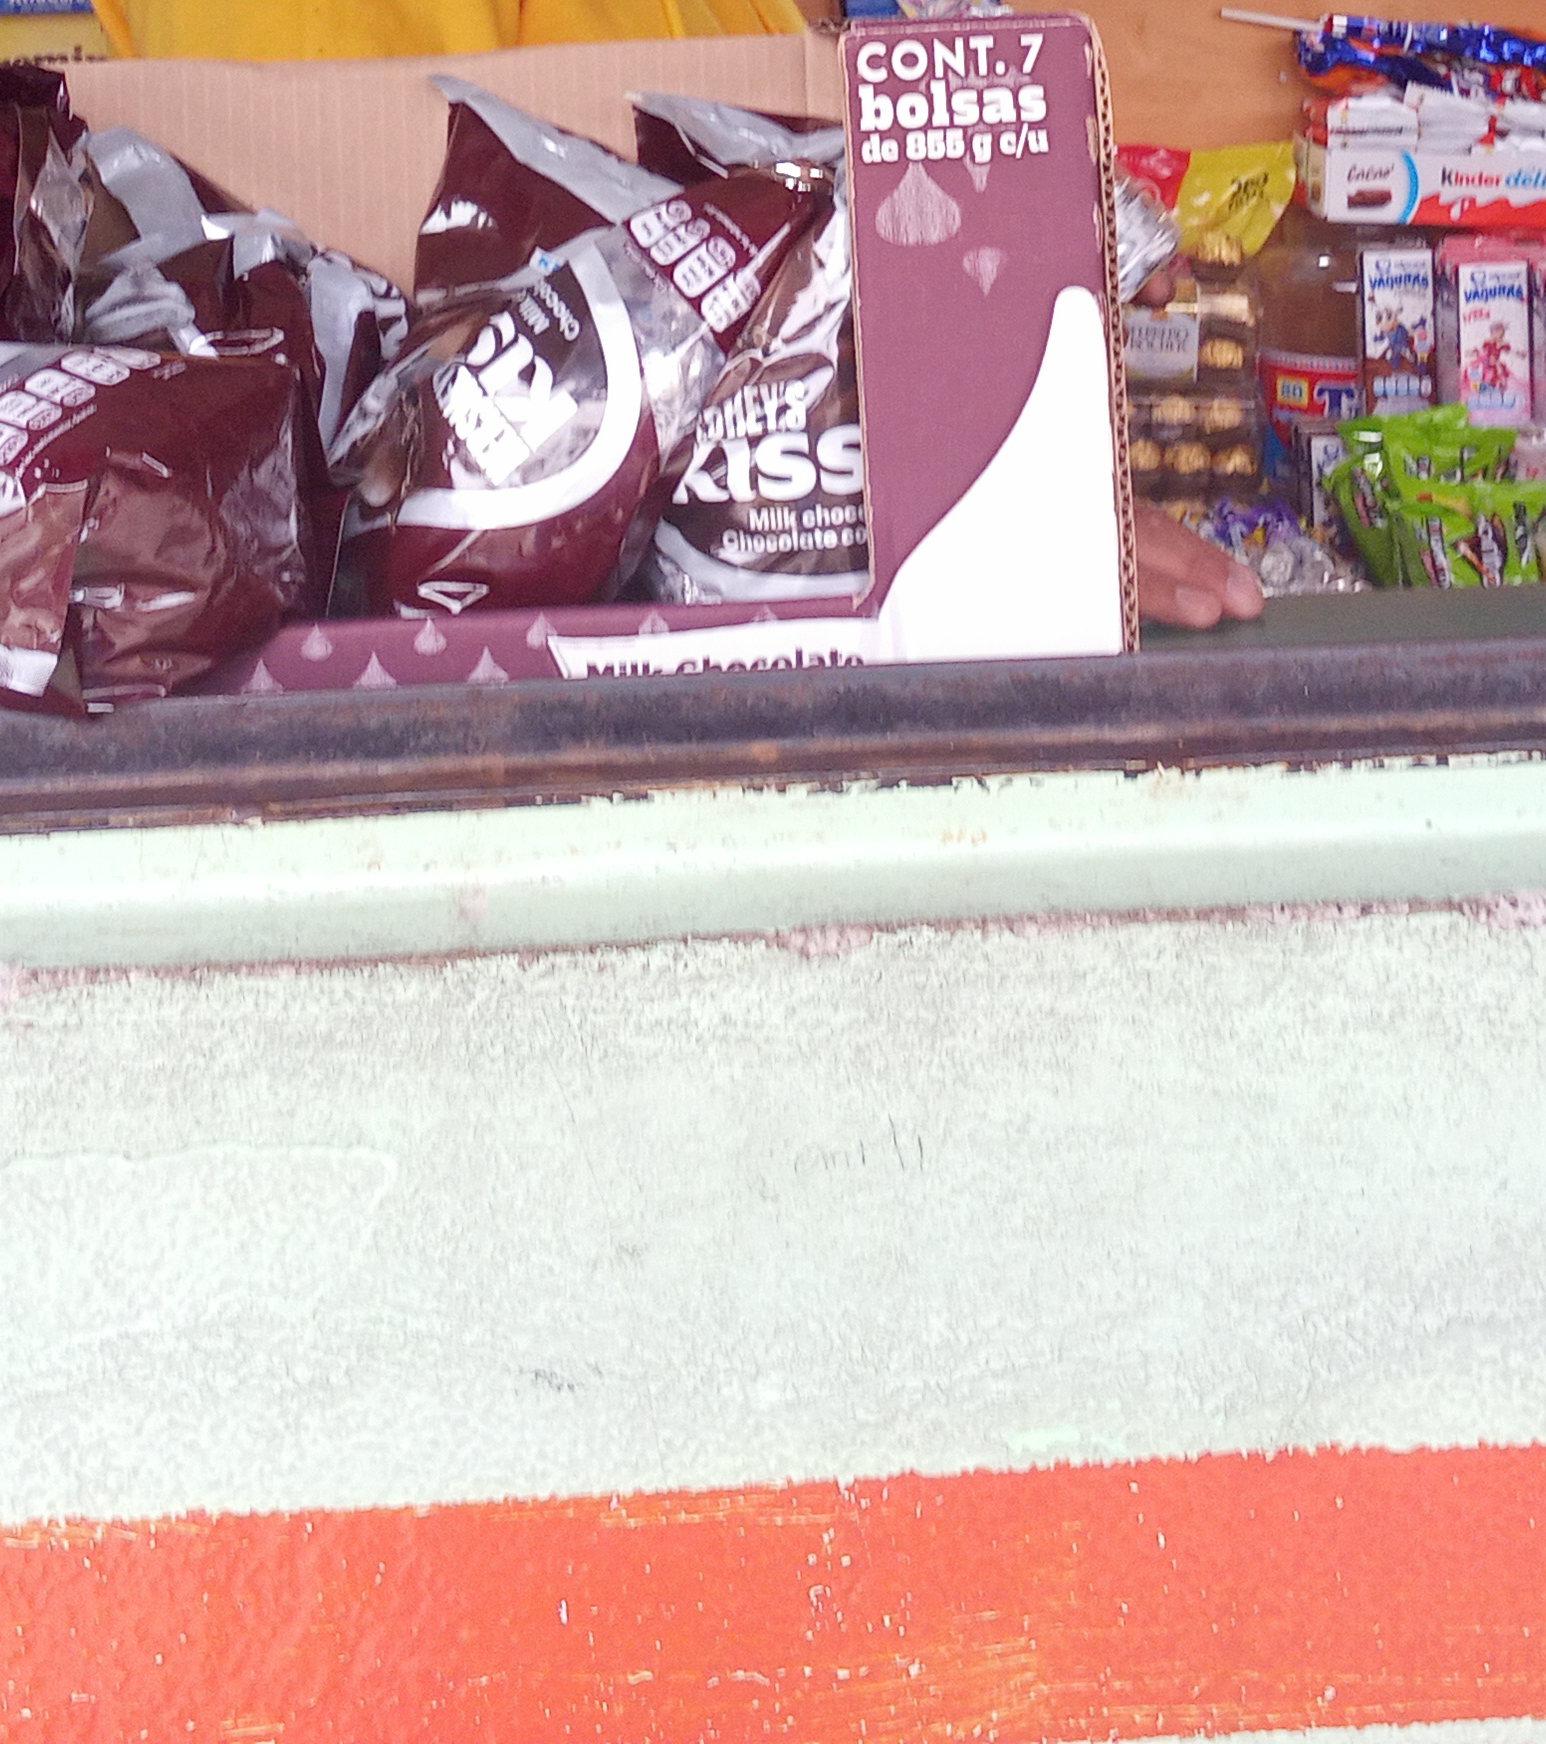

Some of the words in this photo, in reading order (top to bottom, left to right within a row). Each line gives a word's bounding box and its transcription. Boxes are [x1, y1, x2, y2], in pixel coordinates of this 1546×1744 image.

[856, 35, 1006, 83] CONT.
[1019, 33, 1044, 74] 7
[858, 79, 1047, 132] bolsas
[861, 133, 899, 164] de
[972, 132, 993, 164] g
[999, 122, 1049, 159] c/u
[1441, 167, 1503, 188] Kinder
[749, 506, 798, 531] Milk
[722, 528, 838, 554] Chocolate
